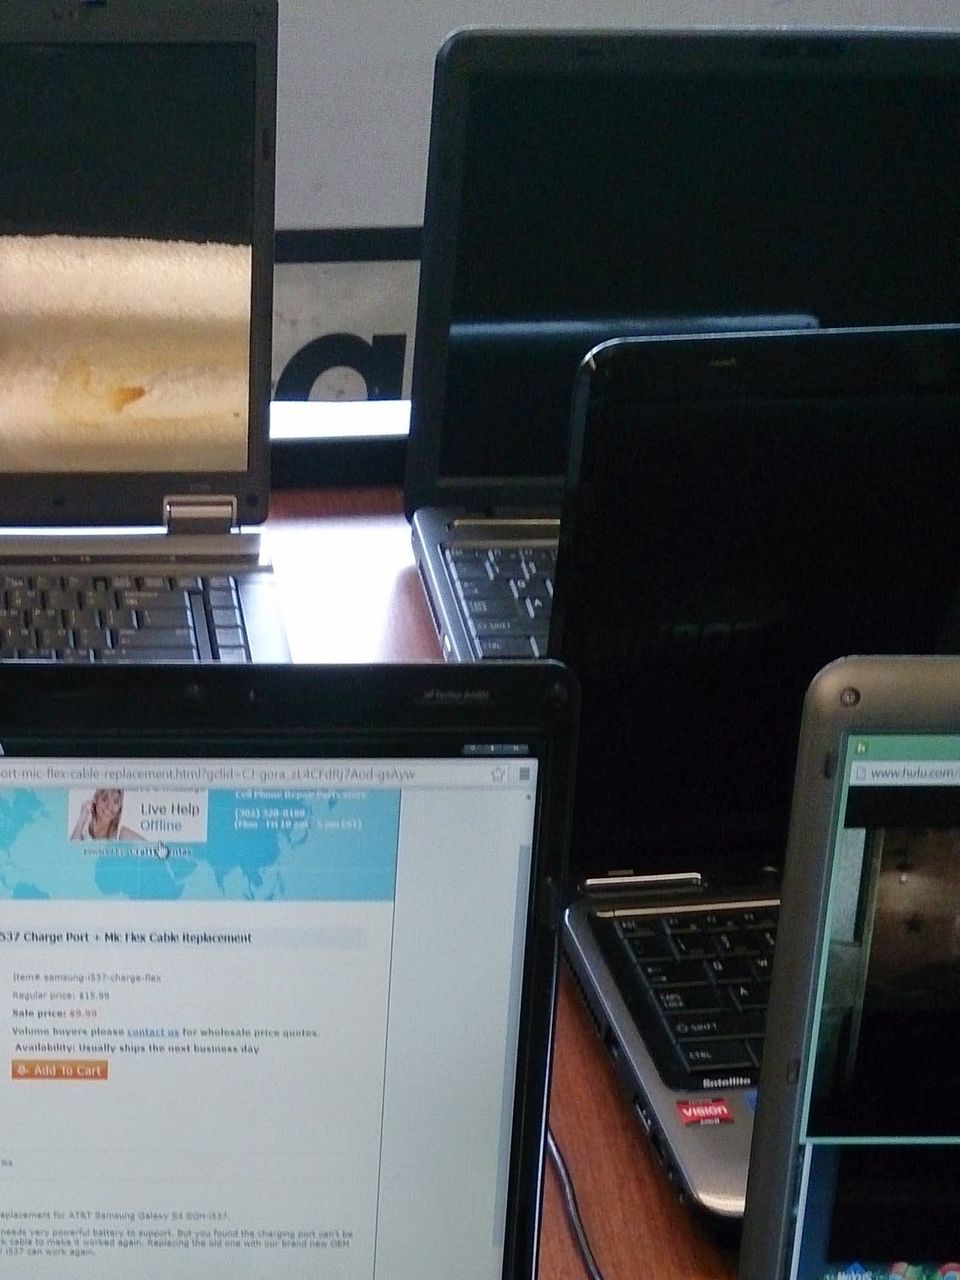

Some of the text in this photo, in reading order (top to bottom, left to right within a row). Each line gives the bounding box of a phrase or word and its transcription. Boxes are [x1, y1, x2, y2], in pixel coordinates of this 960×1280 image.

[141, 802, 200, 818] Live Help
[140, 818, 182, 832] Offline
[23, 932, 60, 945] Charge
[66, 932, 89, 943] Port
[125, 932, 146, 943] Flex
[149, 932, 179, 943] Cable
[182, 932, 251, 946] Replacement
[127, 1027, 165, 1037] contact
[167, 1029, 179, 1037] us
[79, 1042, 116, 1054] Usually
[148, 1043, 165, 1053] the
[193, 1043, 238, 1053] business
[240, 1043, 260, 1055] day
[34, 1065, 102, 1076] Add To Cart
